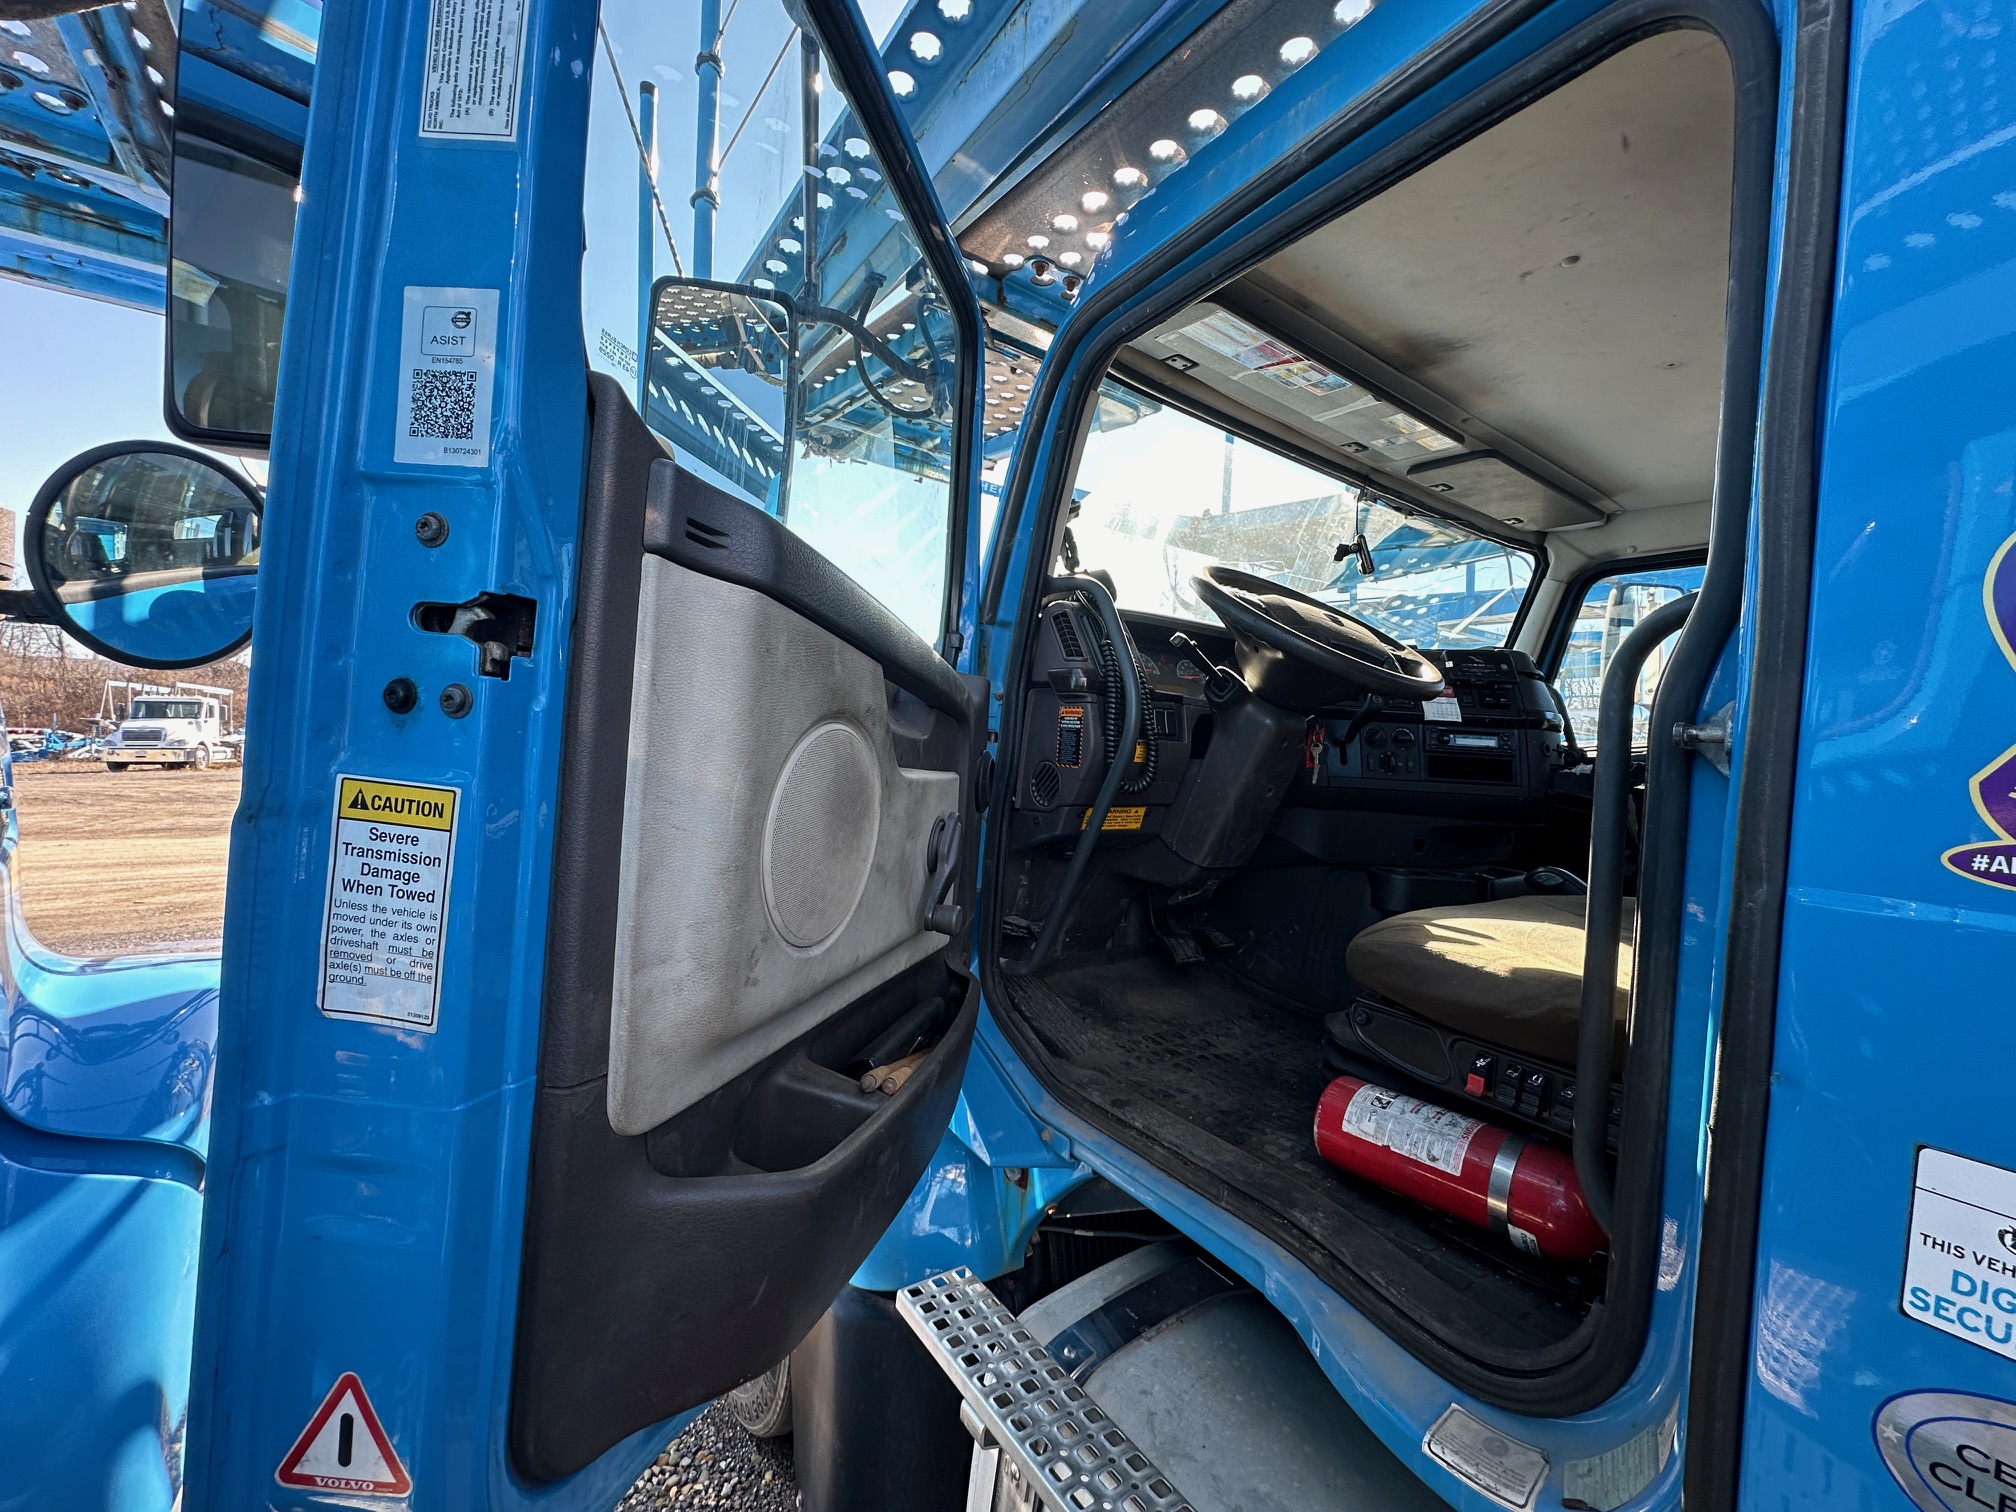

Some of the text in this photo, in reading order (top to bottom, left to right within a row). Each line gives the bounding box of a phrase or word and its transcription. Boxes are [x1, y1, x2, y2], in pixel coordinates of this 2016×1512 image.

[430, 335, 467, 346] ASIST
[431, 357, 463, 365] EN154785
[443, 447, 481, 456] B130724301
[370, 794, 444, 819] CAUTION
[368, 826, 420, 847] Severe
[341, 841, 442, 868] Transmission
[359, 861, 421, 887] Damage
[340, 877, 436, 903] When Towed
[333, 898, 438, 921] Unless the vehicle is
[332, 910, 436, 933] moved under its own
[329, 934, 434, 959] driveshaft must be
[330, 924, 436, 946] power, the axles or
[328, 959, 433, 982] axle(s) must be off the
[329, 947, 434, 971] removed or drive
[327, 971, 368, 987] ground.
[1919, 1232, 2016, 1279] THIS VEH
[1950, 1269, 2016, 1315] DIG
[313, 1476, 375, 1491] VOLVO
